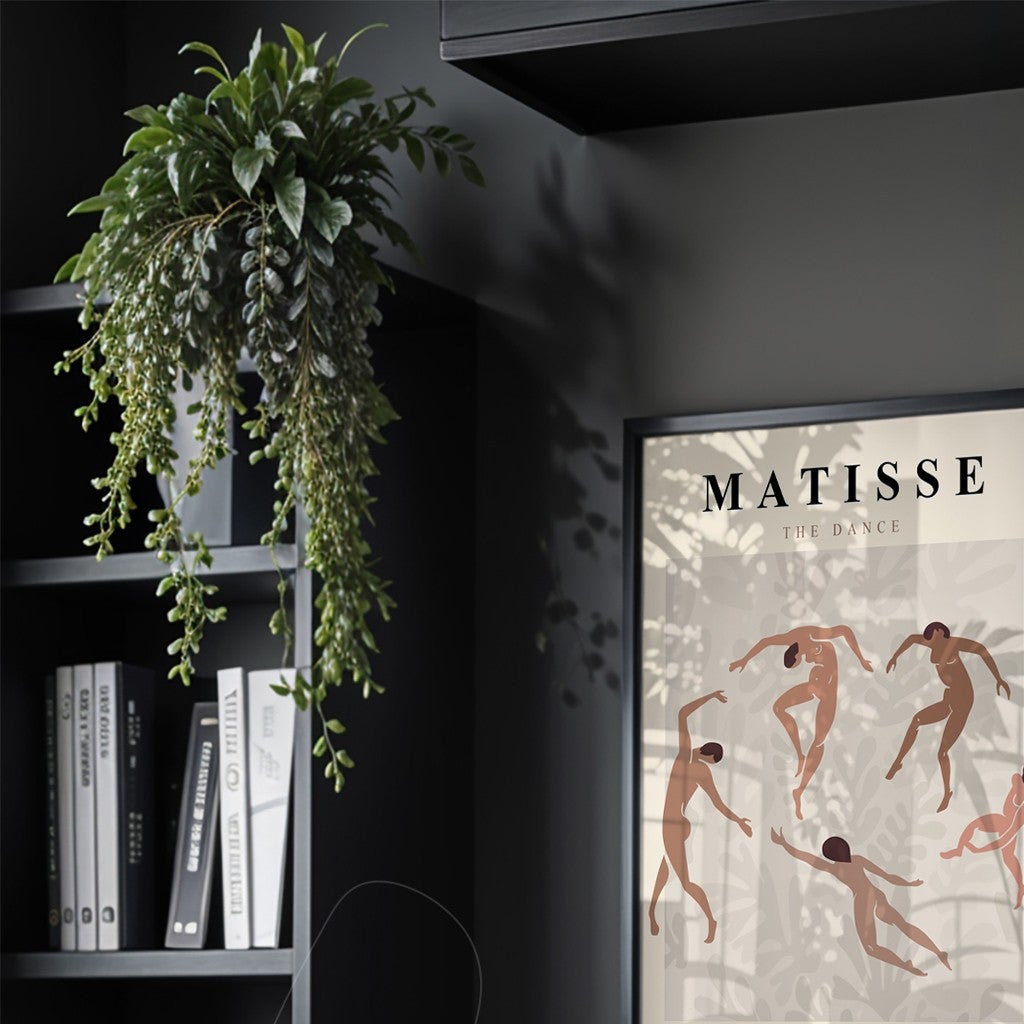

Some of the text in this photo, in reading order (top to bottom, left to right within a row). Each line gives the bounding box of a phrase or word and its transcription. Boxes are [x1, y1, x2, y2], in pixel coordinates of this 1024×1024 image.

[702, 455, 985, 513] MATISSE
[782, 519, 901, 540] THE DANCE
